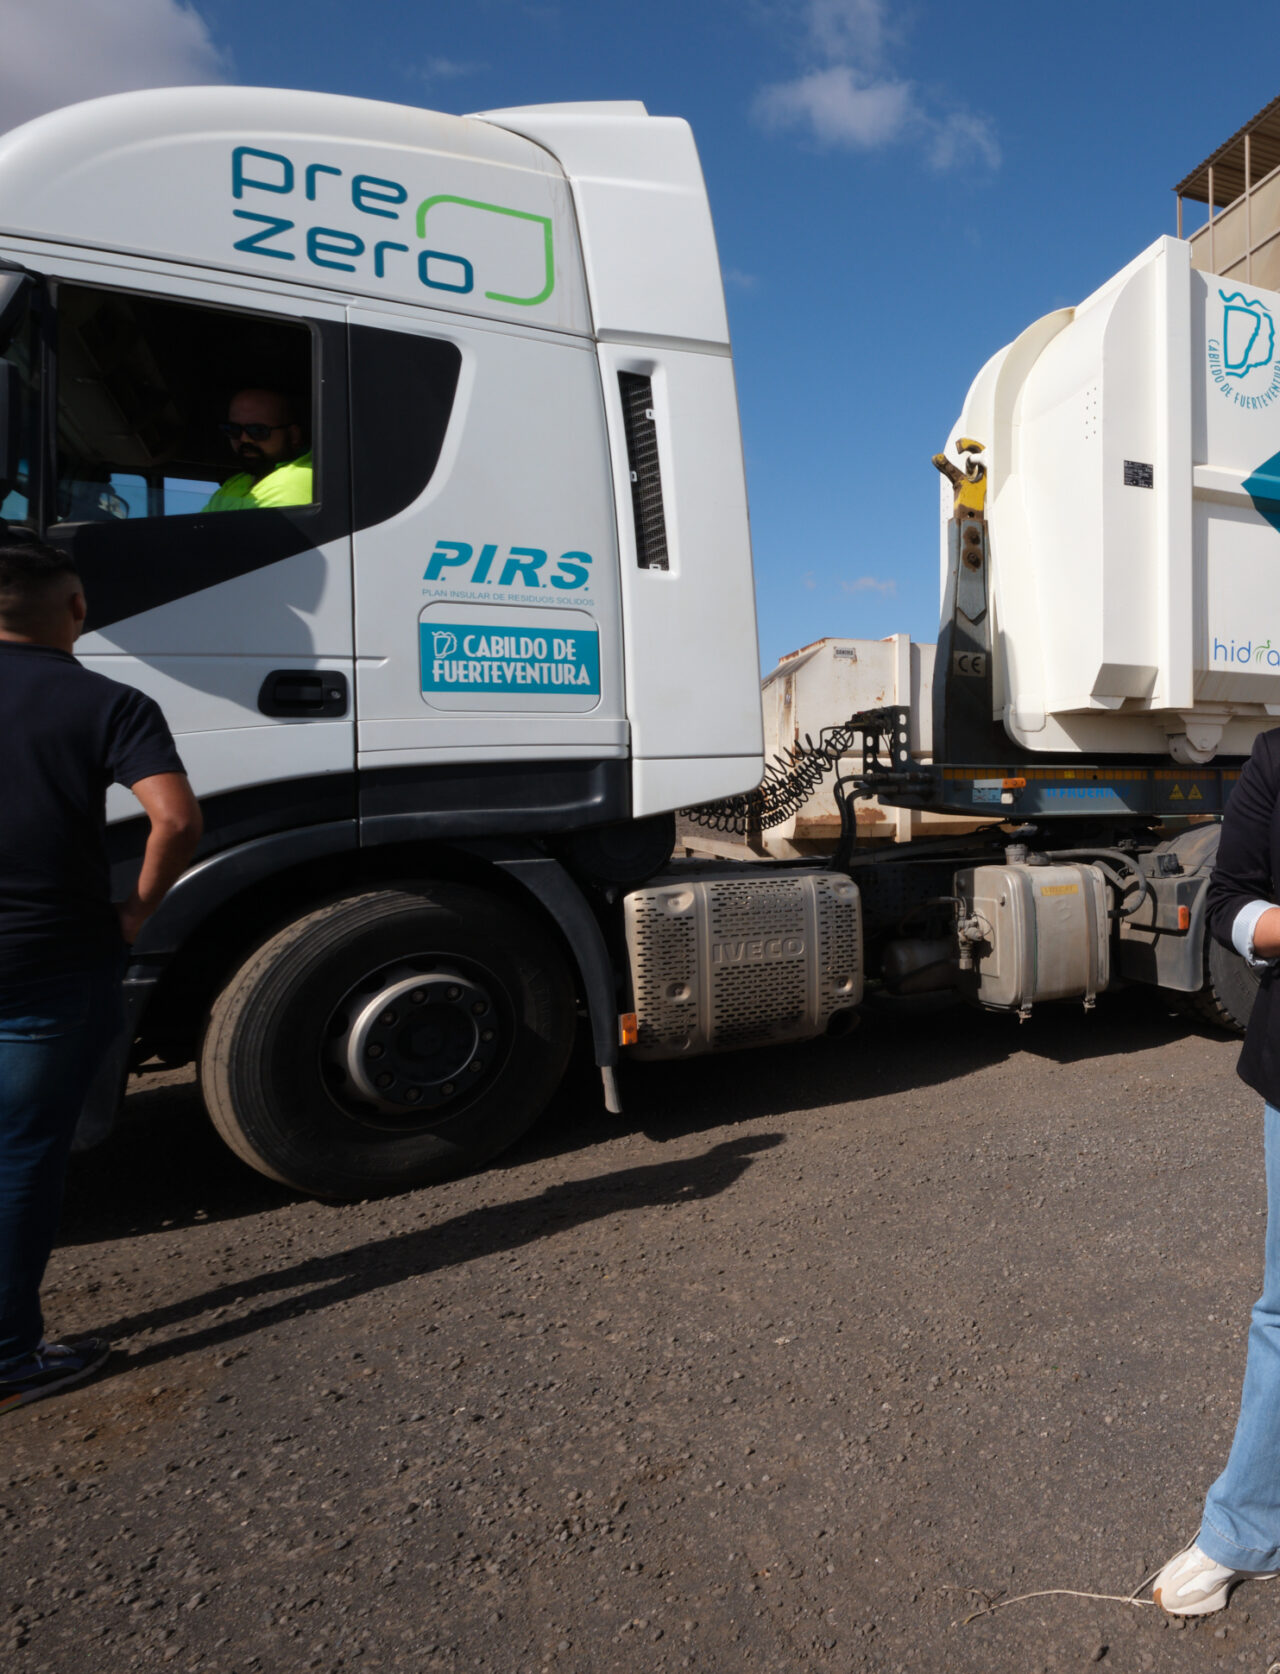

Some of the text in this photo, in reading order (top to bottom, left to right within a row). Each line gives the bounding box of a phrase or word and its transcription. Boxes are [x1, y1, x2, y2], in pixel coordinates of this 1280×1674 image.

[232, 146, 408, 220] pre
[233, 209, 474, 295] zero
[1208, 339, 1225, 383] CABILDO
[1220, 383, 1234, 398] DE
[423, 540, 594, 592] P.I.R.S.
[422, 588, 448, 597] PLAN
[450, 590, 490, 600] INSULAR
[493, 593, 506, 601] DE
[508, 594, 554, 604] RESIDUOS
[463, 635, 577, 661] CABILDO DE
[432, 659, 591, 686] FUERTEVENTURA
[958, 654, 982, 674] CE
[712, 938, 804, 963] IVECO
